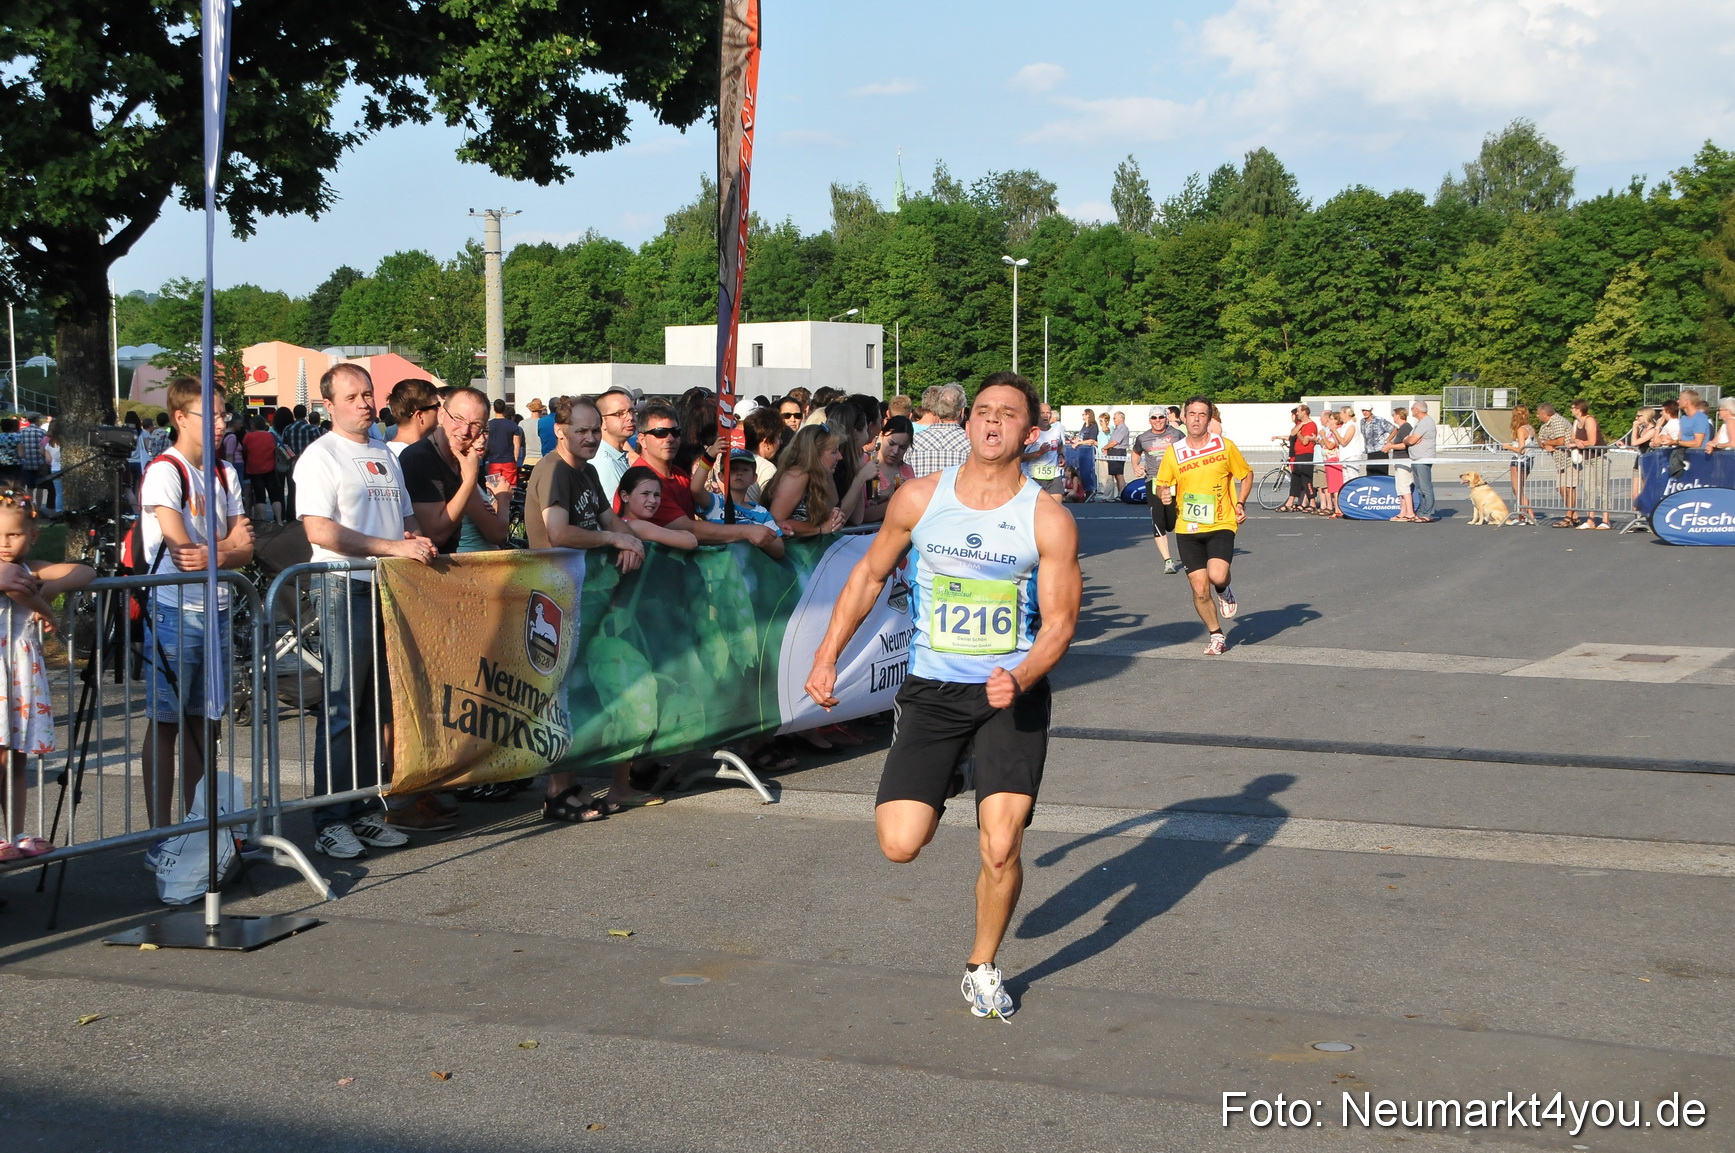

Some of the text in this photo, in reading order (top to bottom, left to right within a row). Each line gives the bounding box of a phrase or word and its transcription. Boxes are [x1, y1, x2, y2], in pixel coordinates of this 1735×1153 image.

[1037, 466, 1052, 475] 155
[1179, 454, 1227, 474] MAX BÖGL
[1358, 494, 1401, 505] Fische
[1186, 503, 1208, 517] 761
[1681, 512, 1735, 526] Fisch
[926, 543, 1017, 566] SCHABMÜLLER
[934, 603, 1012, 636] 1216
[870, 660, 908, 693] Lamm
